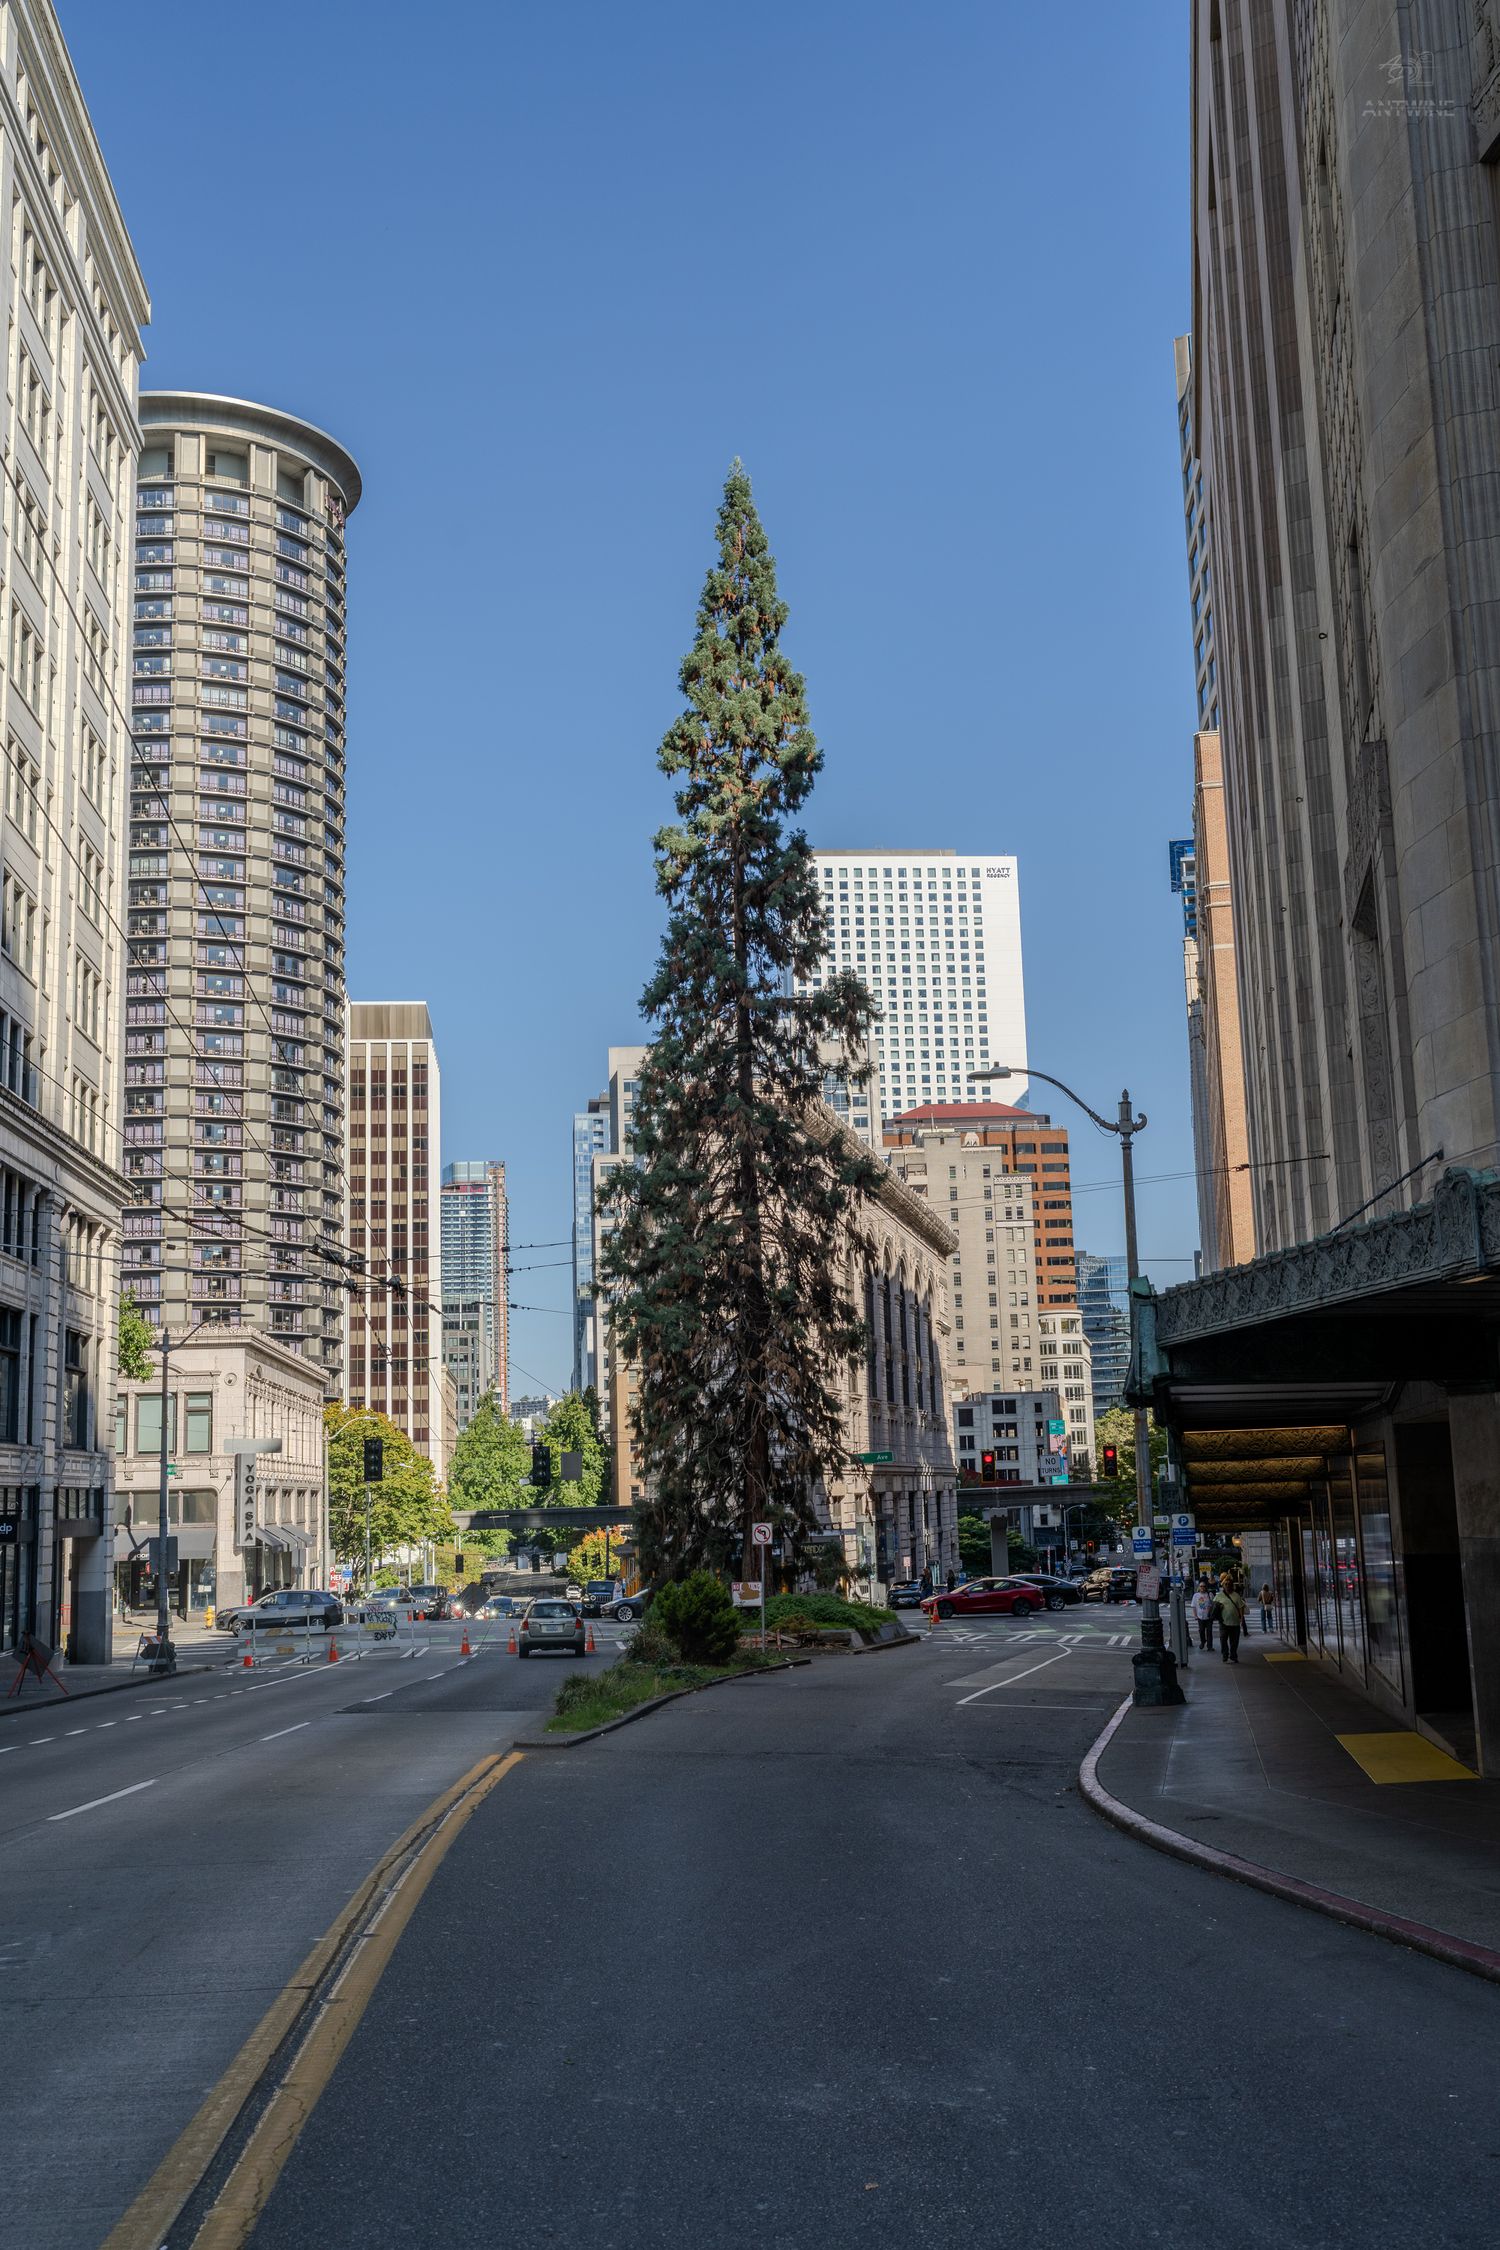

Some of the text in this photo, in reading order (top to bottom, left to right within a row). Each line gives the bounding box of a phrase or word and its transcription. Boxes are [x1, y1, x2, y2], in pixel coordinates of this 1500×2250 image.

[1045, 1457, 1056, 1465] NO
[244, 1464, 255, 1541] YOGA SPA
